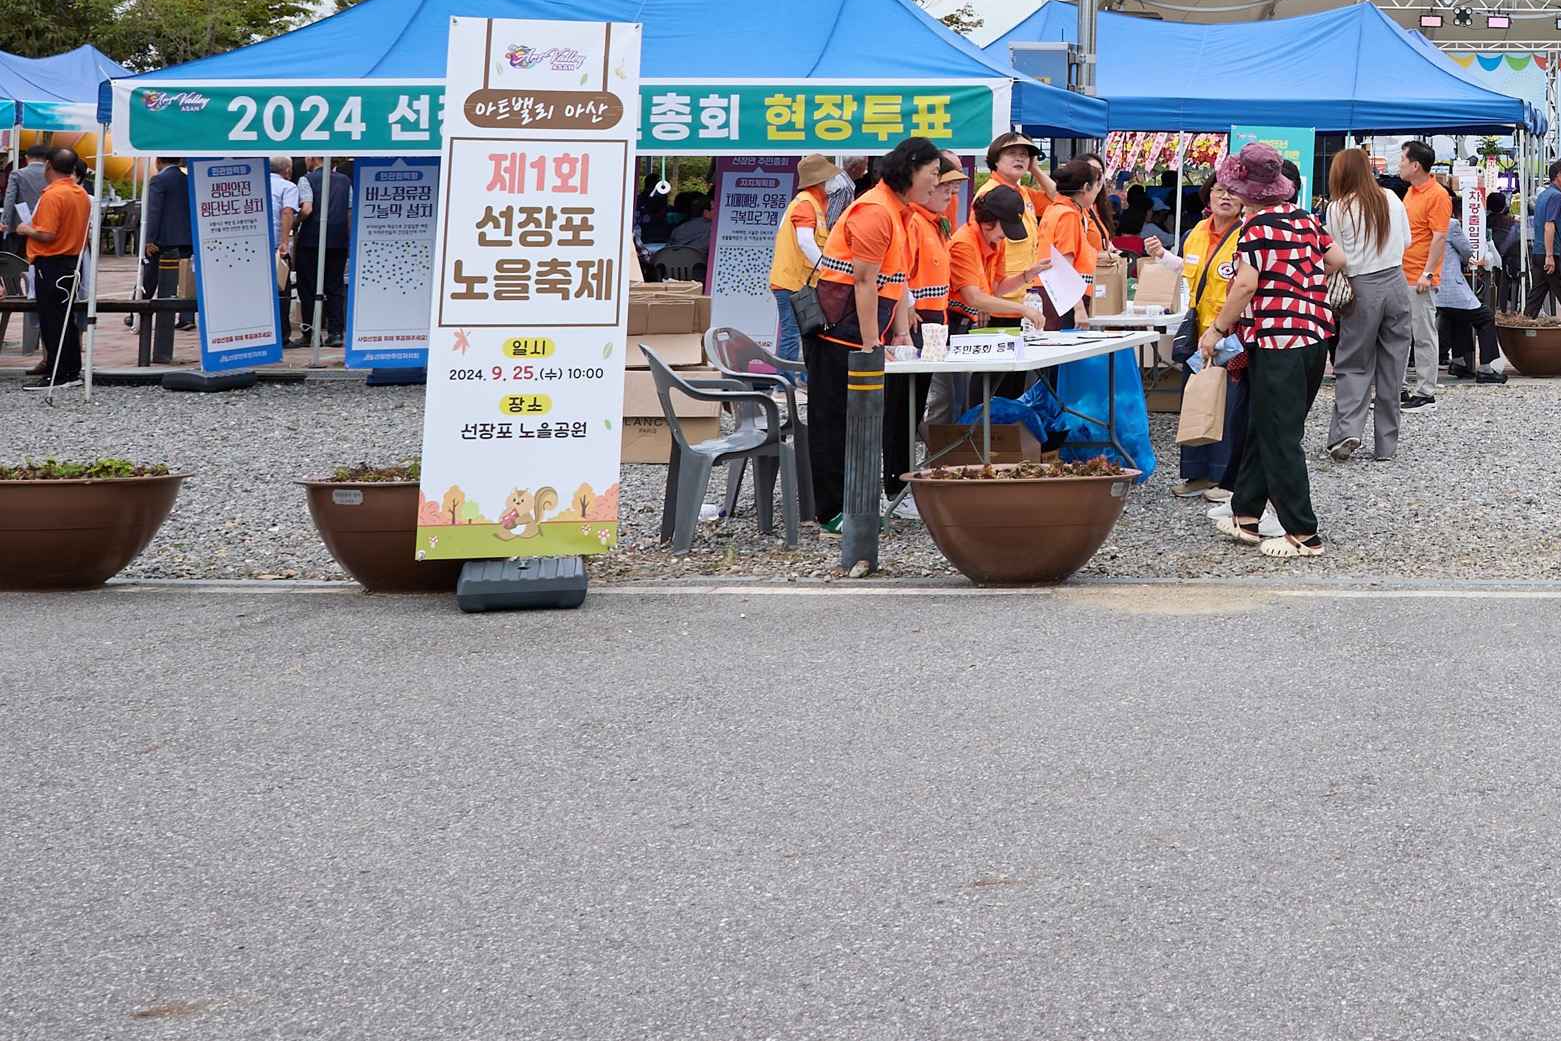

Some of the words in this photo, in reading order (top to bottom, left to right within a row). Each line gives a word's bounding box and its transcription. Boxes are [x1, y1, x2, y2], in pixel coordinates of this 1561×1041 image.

[227, 95, 366, 142] 2024
[388, 94, 445, 142] 선
[636, 92, 740, 141] 총회
[764, 93, 953, 142] 현장투표
[475, 96, 553, 125] 아트밸리
[564, 101, 609, 124] 아산
[486, 152, 590, 194] 제1회
[366, 185, 433, 201] 버스정류장
[243, 197, 265, 215] 설치
[363, 203, 403, 219] 그늘막
[406, 203, 433, 219] 설치
[475, 205, 596, 247] 선장포
[450, 257, 614, 301] 노을축제
[512, 339, 547, 356] 일시
[953, 344, 993, 355] 주민총회
[449, 368, 487, 382] 2024.
[491, 365, 507, 382] 9.
[567, 367, 605, 380] 10:00
[508, 396, 544, 413] 장소
[461, 423, 514, 440] 선장포
[518, 421, 588, 439] 노을공원
